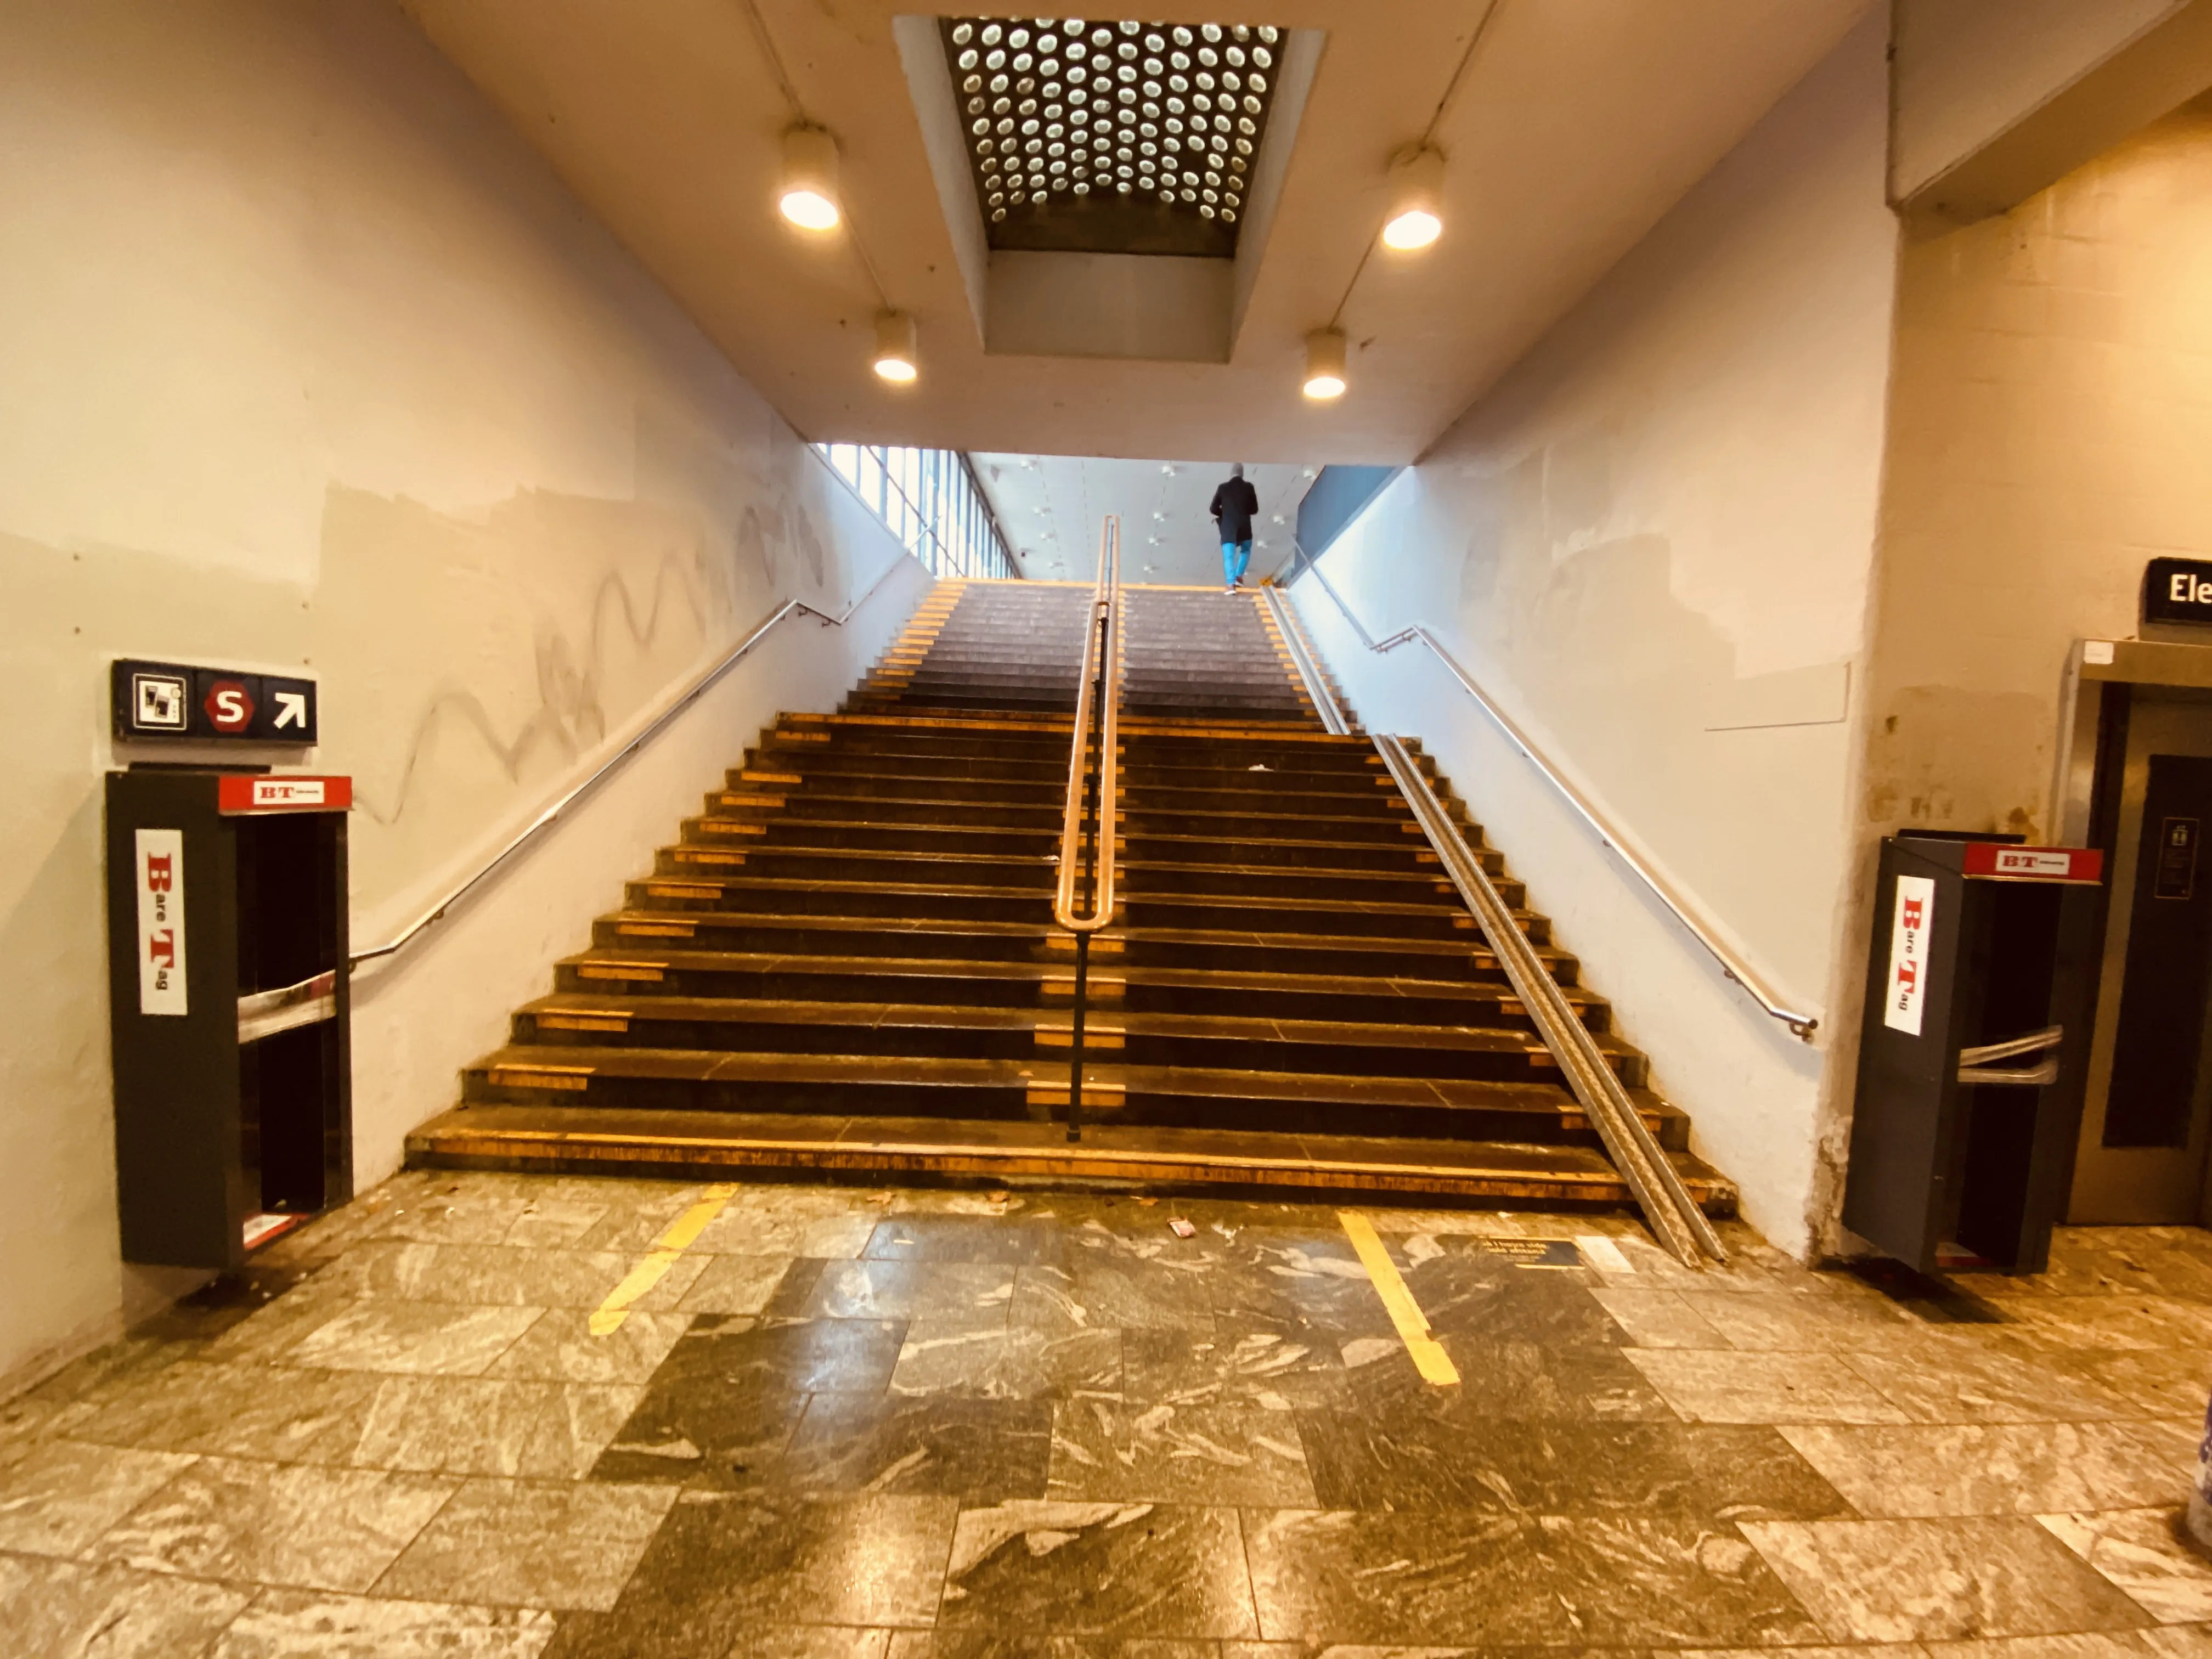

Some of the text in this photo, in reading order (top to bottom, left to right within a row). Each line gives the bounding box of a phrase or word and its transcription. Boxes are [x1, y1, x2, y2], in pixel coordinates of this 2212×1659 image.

[215, 690, 244, 723] S
[260, 787, 295, 798] BT
[2003, 855, 2038, 868] BT
[147, 851, 176, 992] Bare Tag
[1898, 896, 1922, 1012] Bare Tag
